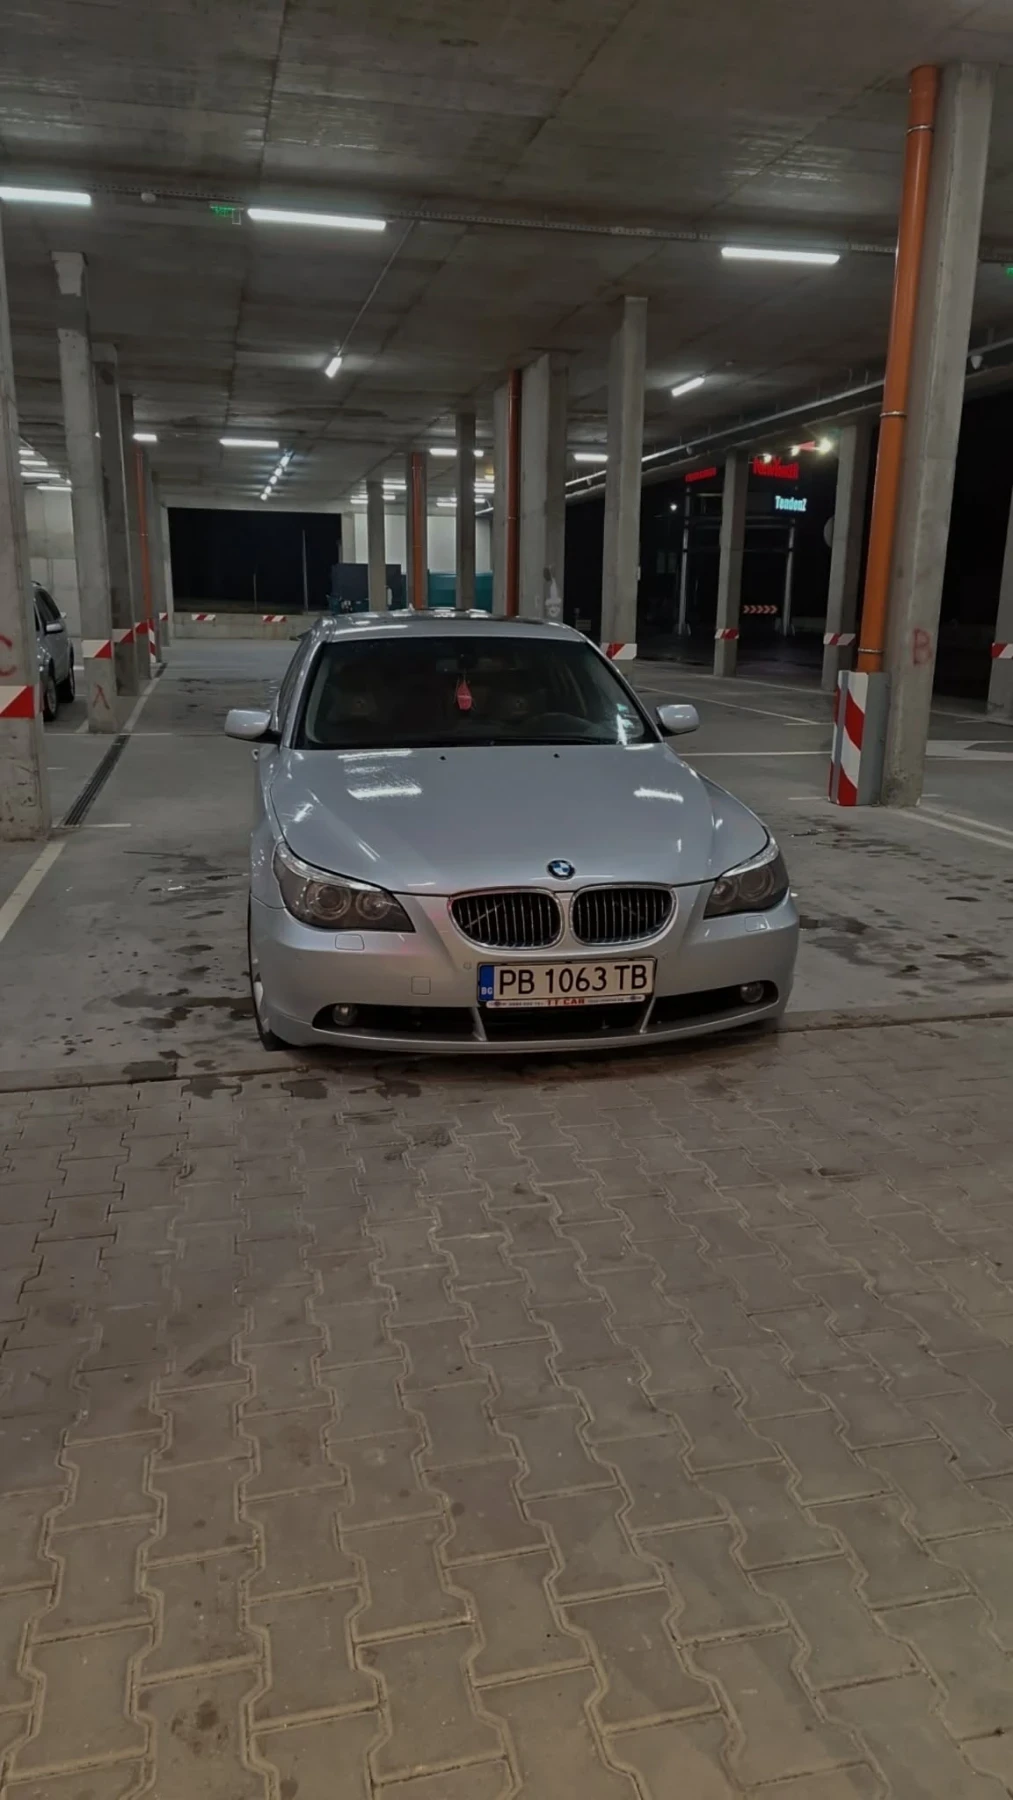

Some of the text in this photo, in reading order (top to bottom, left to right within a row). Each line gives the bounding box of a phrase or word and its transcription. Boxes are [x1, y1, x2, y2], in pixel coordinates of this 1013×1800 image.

[499, 964, 648, 995] PB 1063 TB
[481, 986, 493, 996] BG
